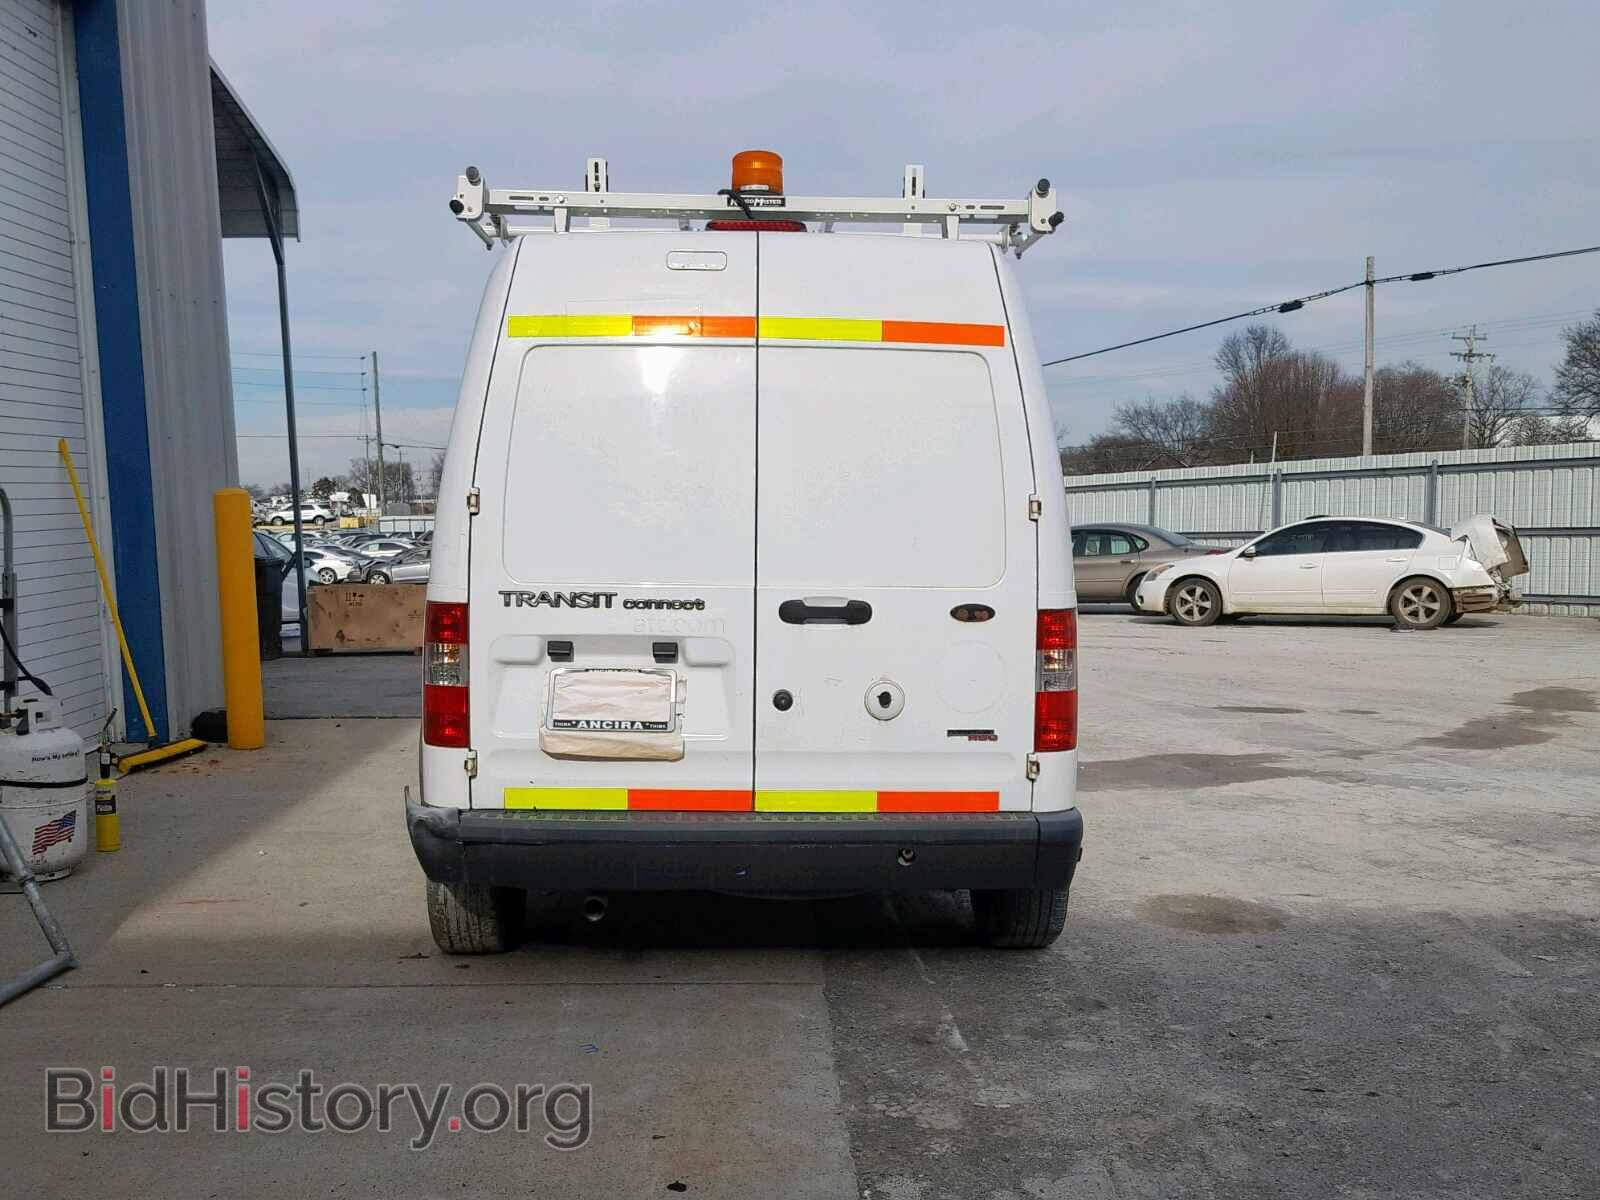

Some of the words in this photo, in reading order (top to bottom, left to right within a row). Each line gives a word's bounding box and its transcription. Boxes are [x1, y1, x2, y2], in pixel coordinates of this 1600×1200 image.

[498, 590, 618, 609] TRANSIT
[622, 598, 706, 610] connect
[576, 720, 644, 730] ANCIRA
